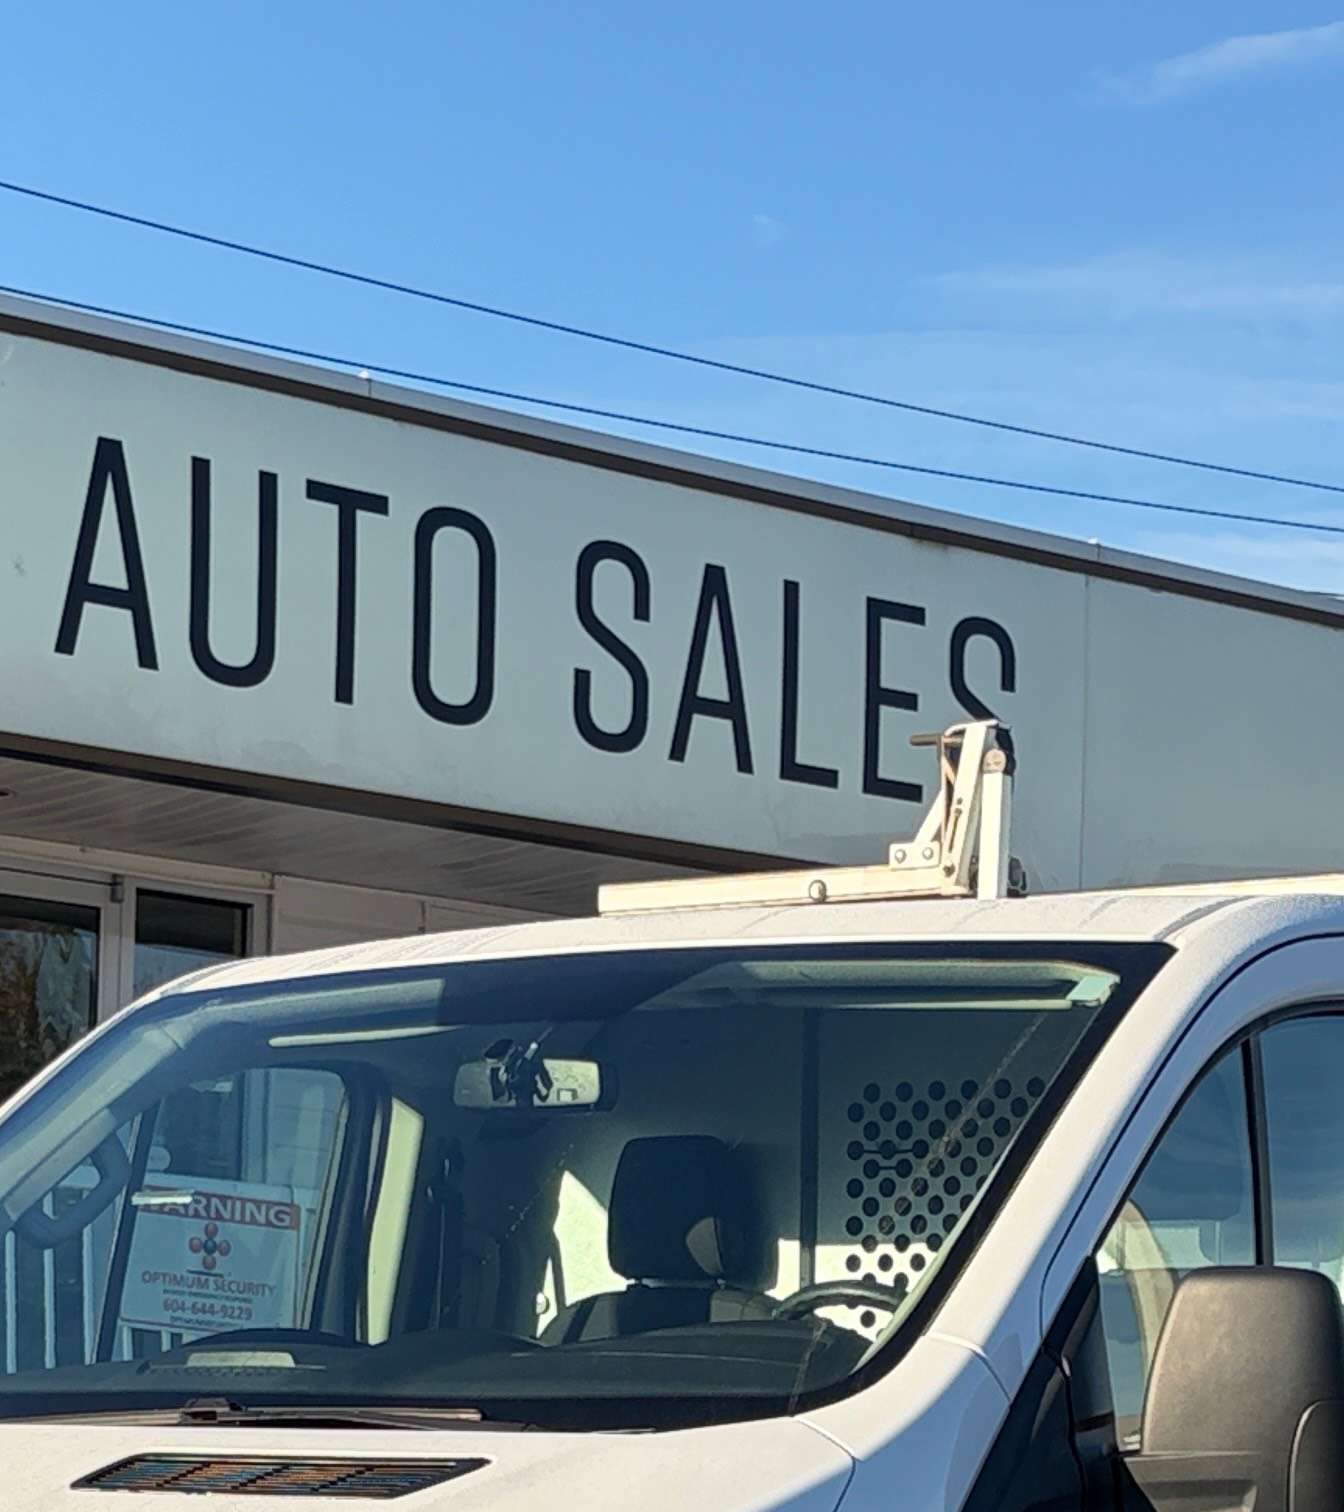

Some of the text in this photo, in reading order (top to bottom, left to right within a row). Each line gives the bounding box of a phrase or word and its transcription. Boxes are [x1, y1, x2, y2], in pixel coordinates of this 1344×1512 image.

[54, 436, 497, 726] AUTO
[573, 539, 1017, 804] SALES
[142, 1270, 209, 1290] OPTIMUM
[214, 1277, 277, 1298] SECURITY
[163, 1297, 253, 1321] 604-644-9229
